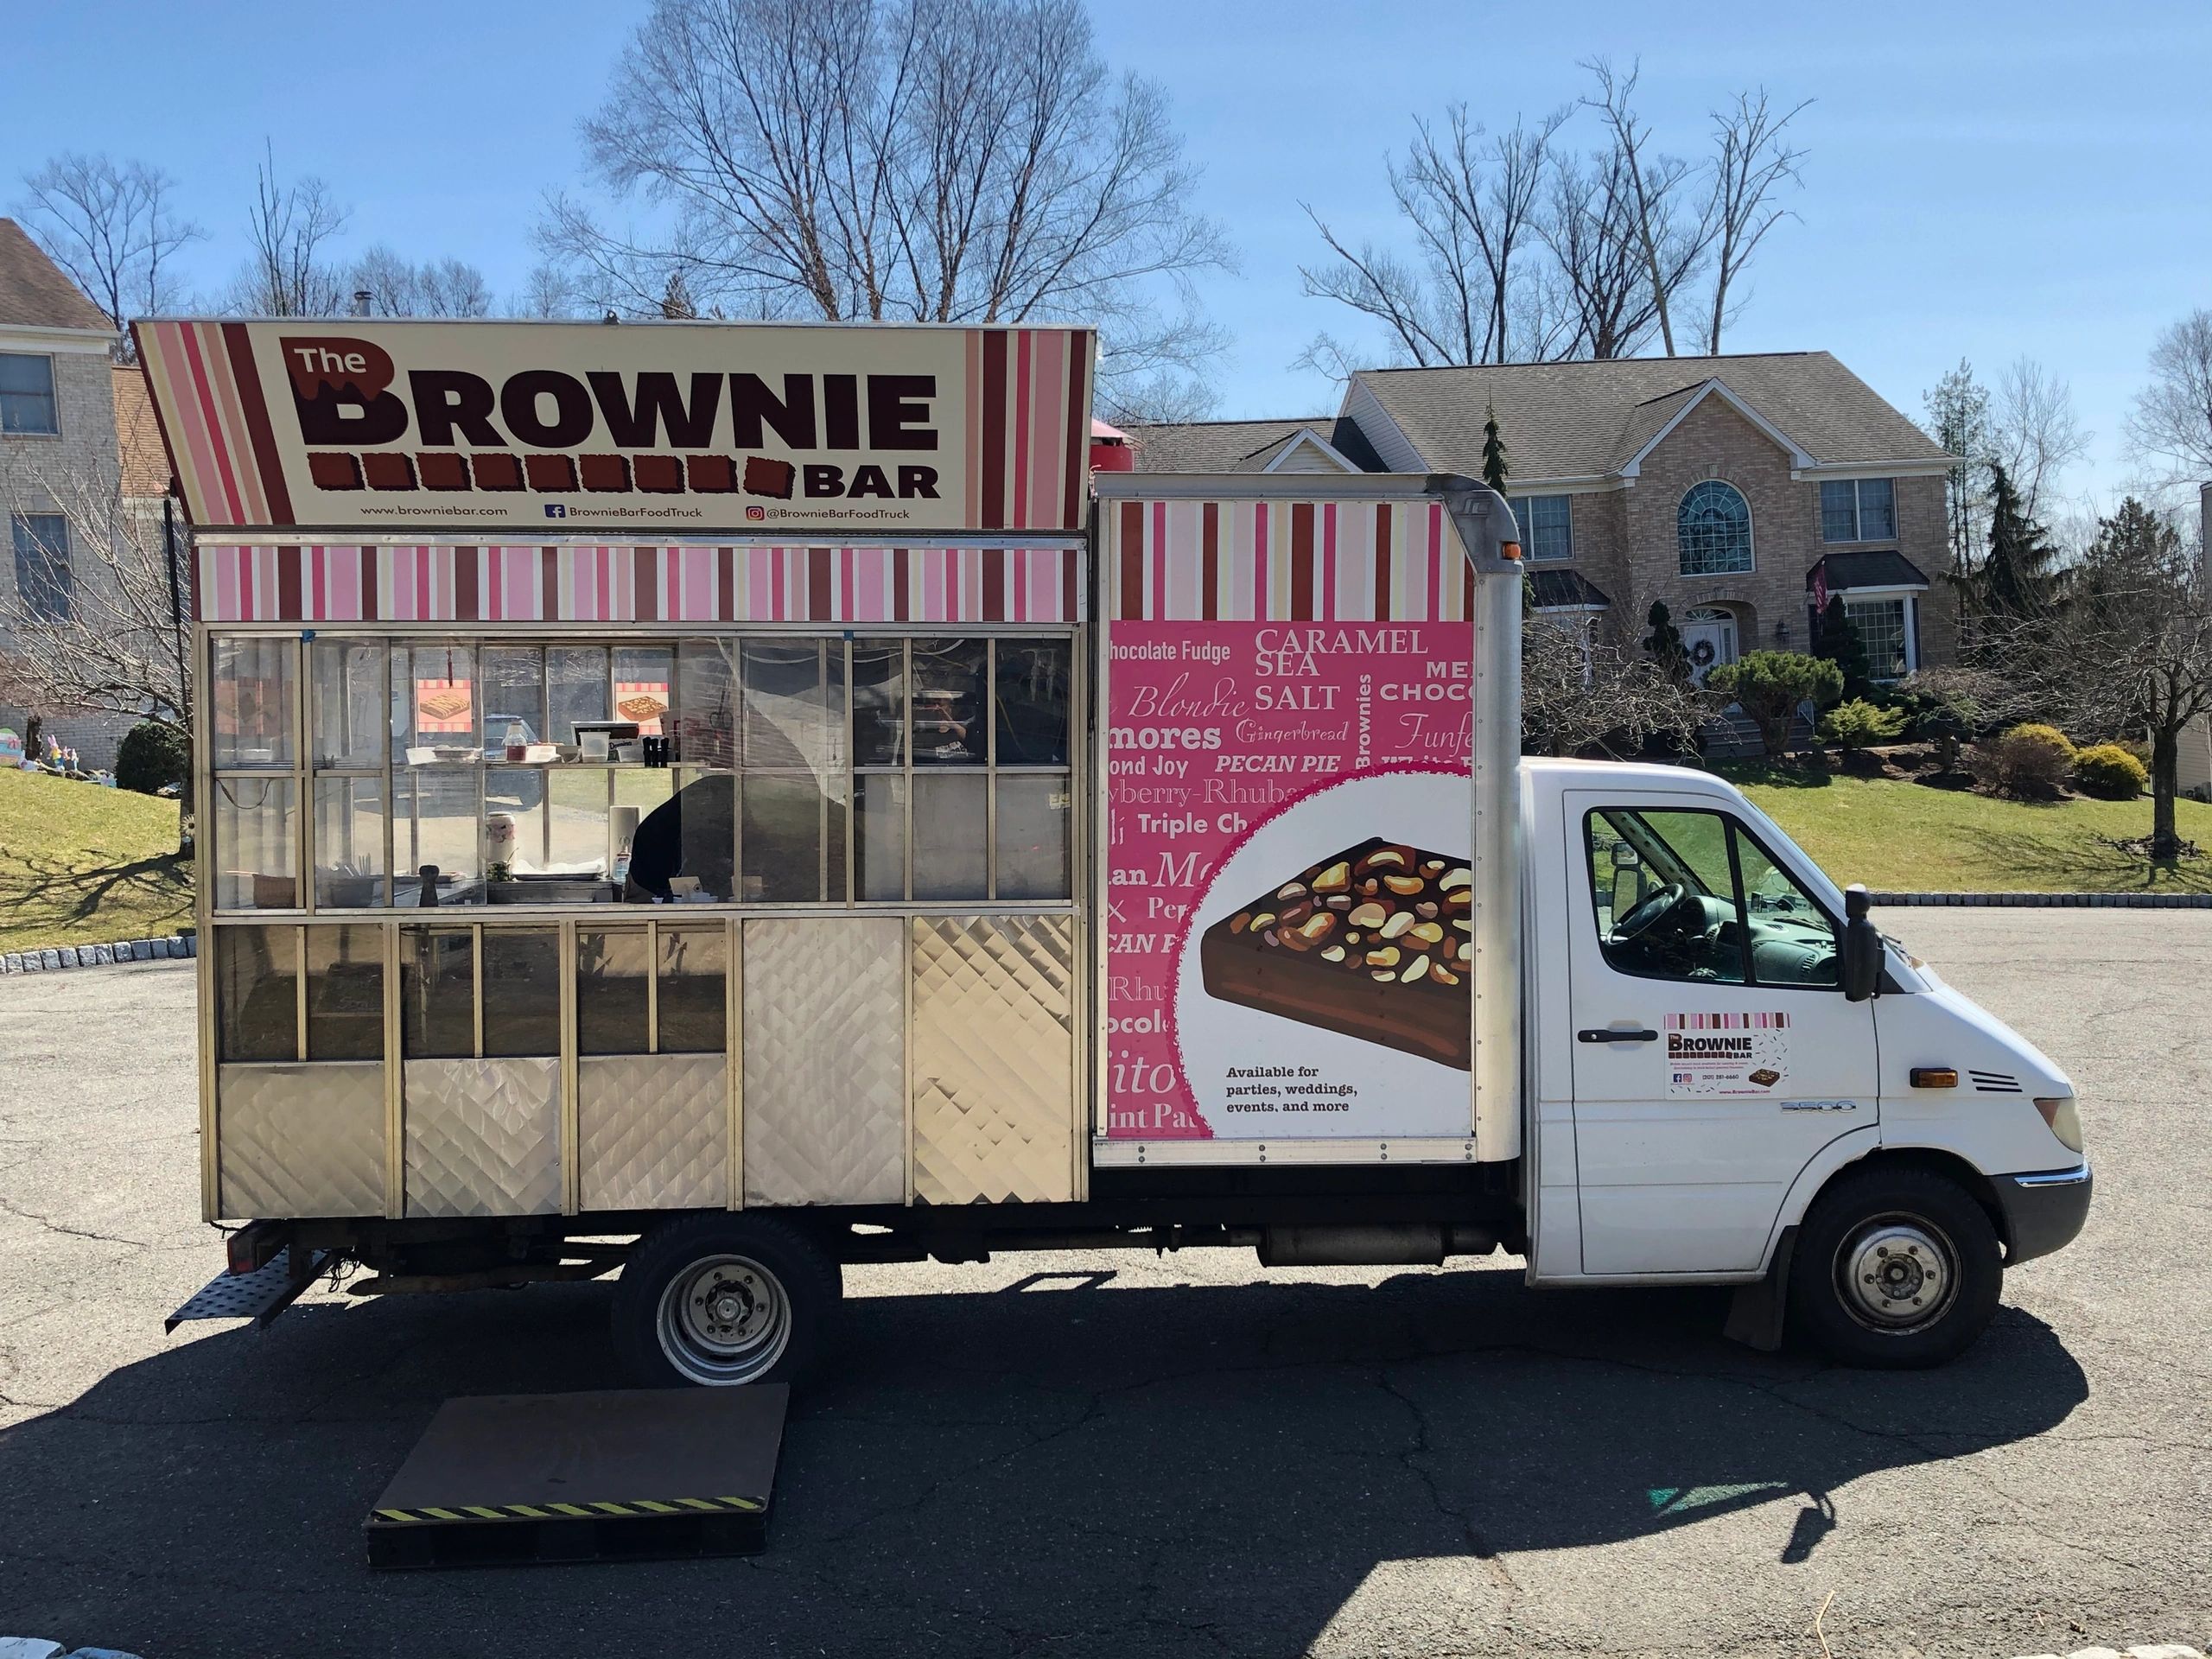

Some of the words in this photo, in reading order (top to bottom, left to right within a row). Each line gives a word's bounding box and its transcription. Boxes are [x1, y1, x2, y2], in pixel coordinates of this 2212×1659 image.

[294, 347, 366, 373] The
[279, 337, 938, 450] BROWNIE
[803, 464, 941, 499] BAR
[360, 505, 508, 517] www.browniebar.com
[569, 506, 703, 518] BrownieBarFoodTruck
[766, 507, 910, 519] @BrownieBarFoodTruck
[1182, 640, 1230, 665] Fudge
[1255, 629, 1428, 654] CARAMEL
[1255, 652, 1320, 677] SEA
[1427, 661, 1473, 679] ME
[1128, 671, 1250, 717] Blondie
[1255, 685, 1340, 710] SALT
[1236, 718, 1350, 743] Gingerbread
[1356, 674, 1371, 770] Brownies
[1109, 727, 1222, 750] mores
[1153, 755, 1189, 779] Joy
[1215, 755, 1297, 772] PECAN
[1300, 755, 1341, 772] PIE
[1138, 812, 1208, 839] Triple
[1109, 868, 1148, 886] an
[1109, 1009, 1167, 1033] ocol
[1669, 1033, 1752, 1051] BROWNIE
[1109, 1050, 1176, 1094] ito
[1226, 1066, 1294, 1077] Available
[1298, 1066, 1319, 1077] for
[1226, 1084, 1281, 1097] parties,
[1285, 1083, 1357, 1097] weddings,
[1282, 1102, 1309, 1112] and
[1313, 1103, 1350, 1112] more
